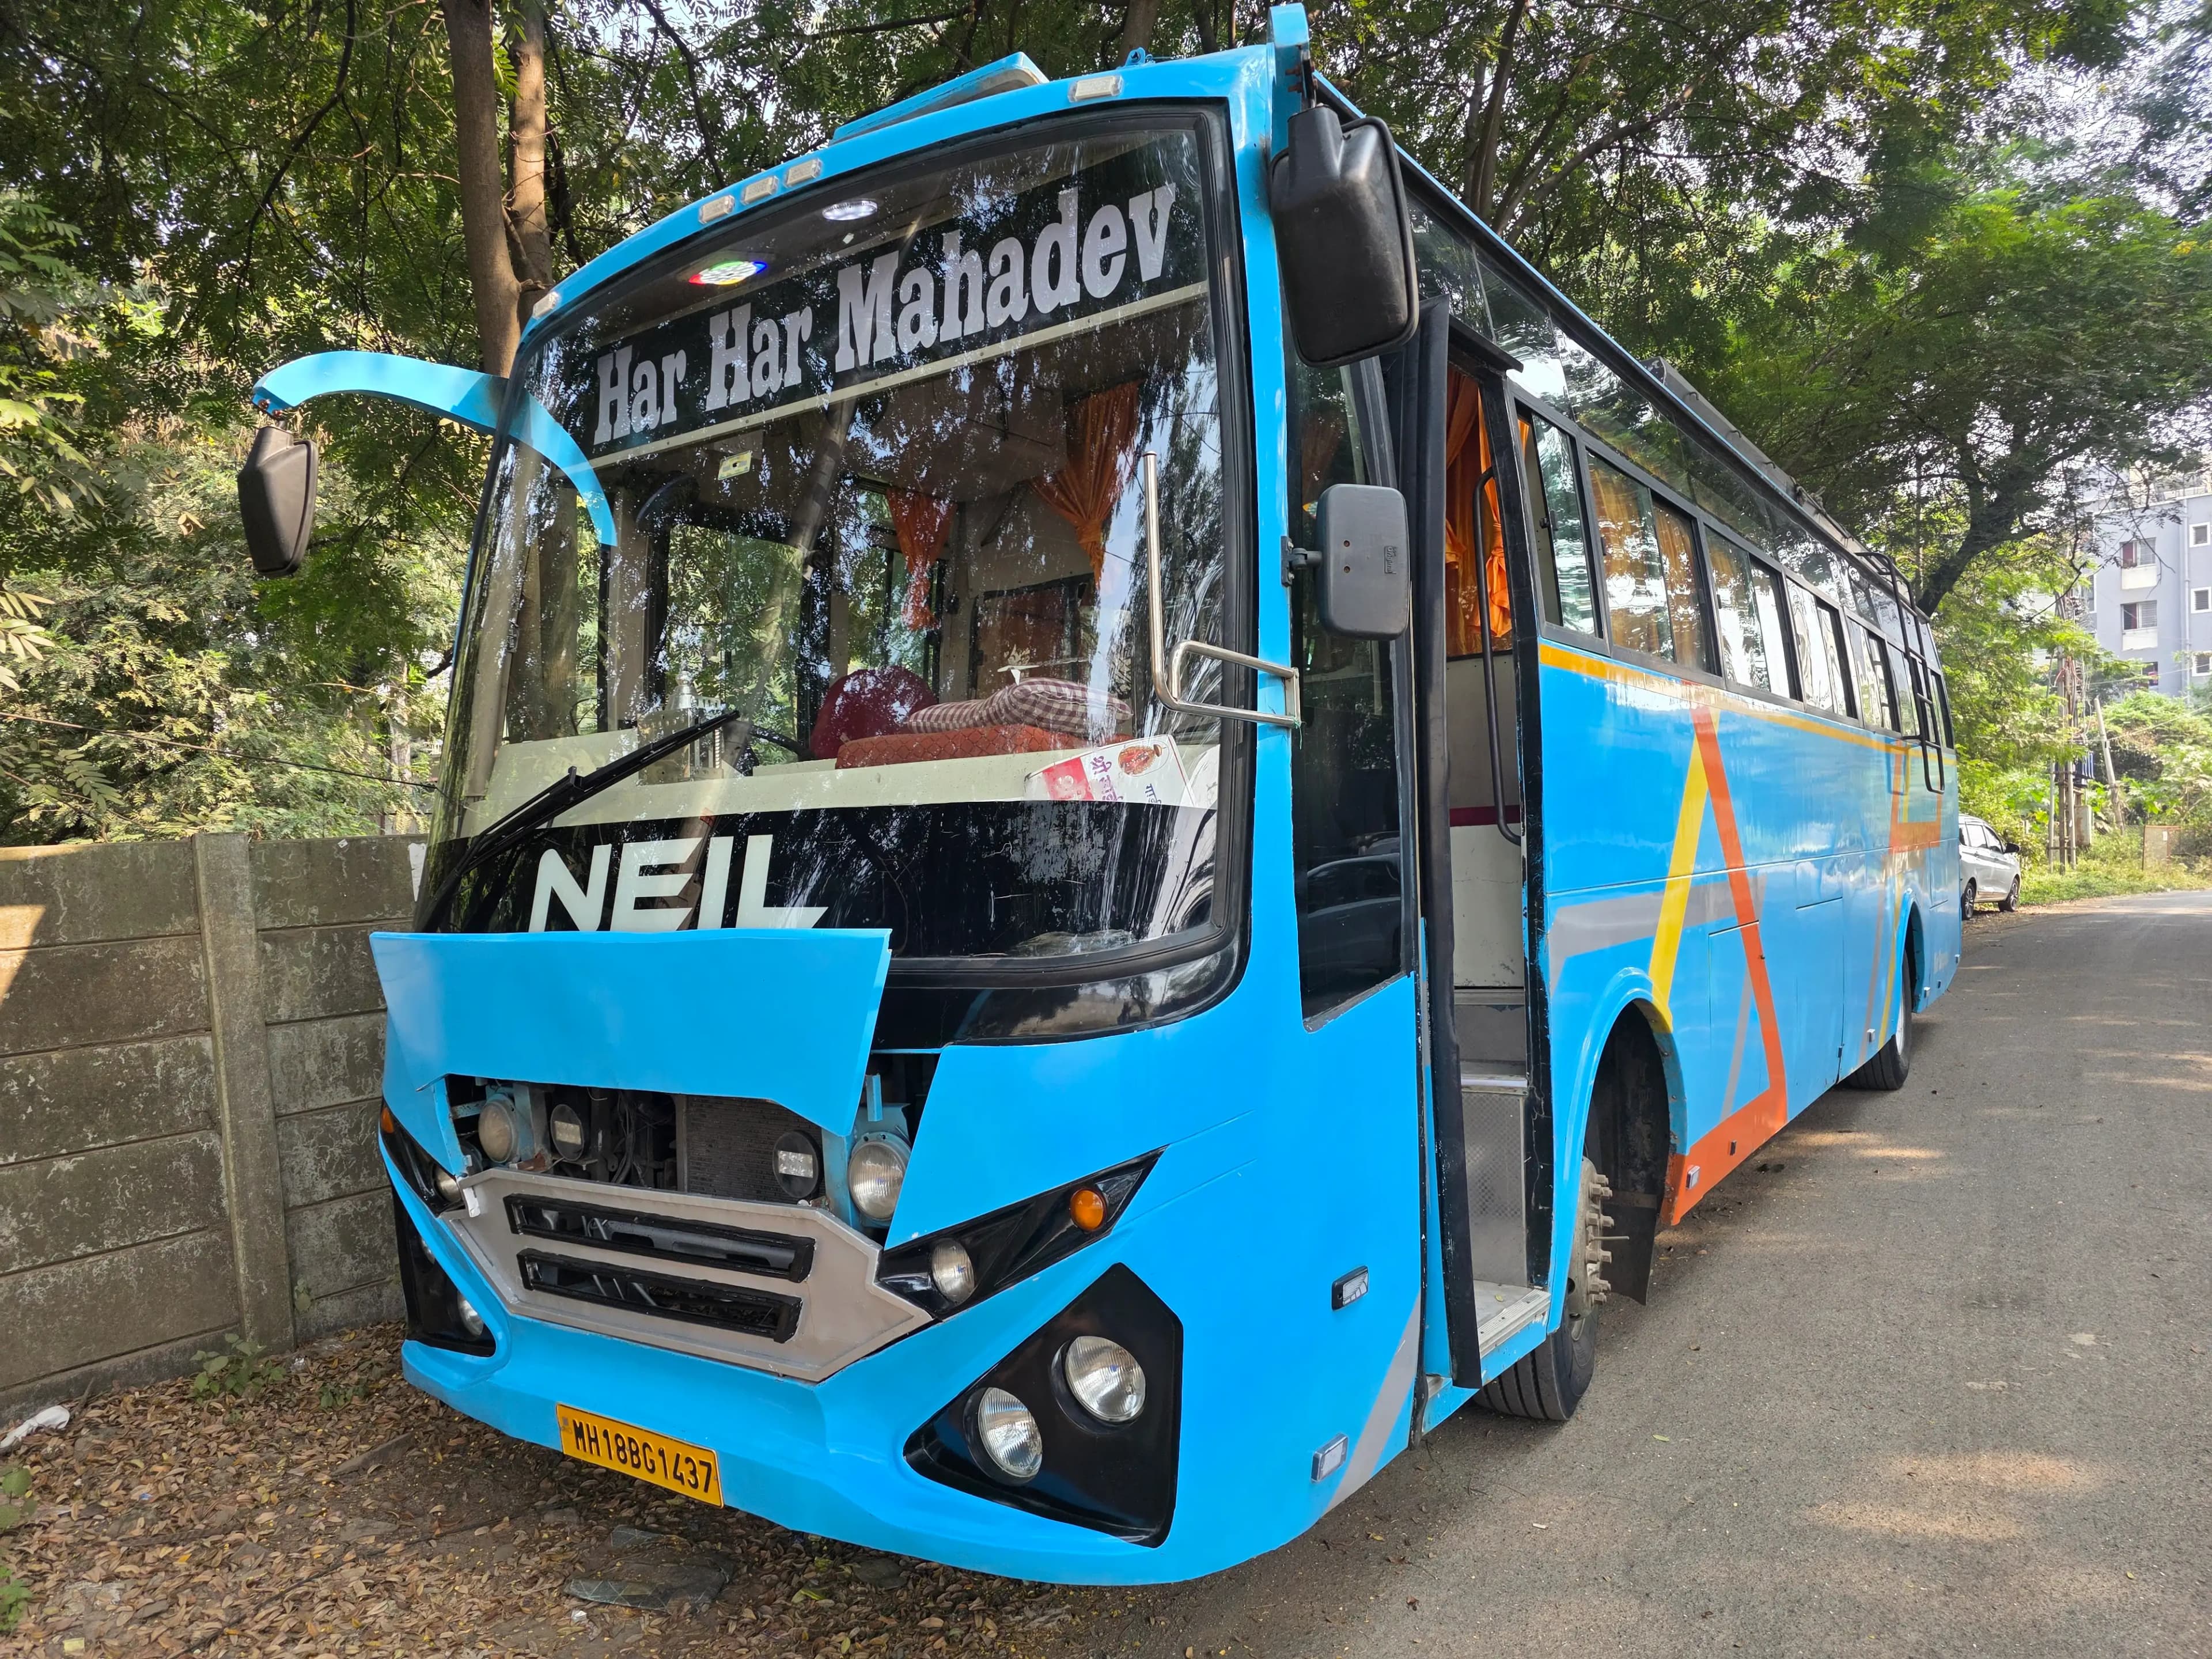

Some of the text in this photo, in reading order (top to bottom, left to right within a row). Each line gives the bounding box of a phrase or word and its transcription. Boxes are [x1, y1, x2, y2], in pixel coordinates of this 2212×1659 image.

[594, 183, 1177, 445] Har Har Mahadev
[528, 835, 828, 932] NEIL
[573, 1419, 713, 1493] MH18BG1437
